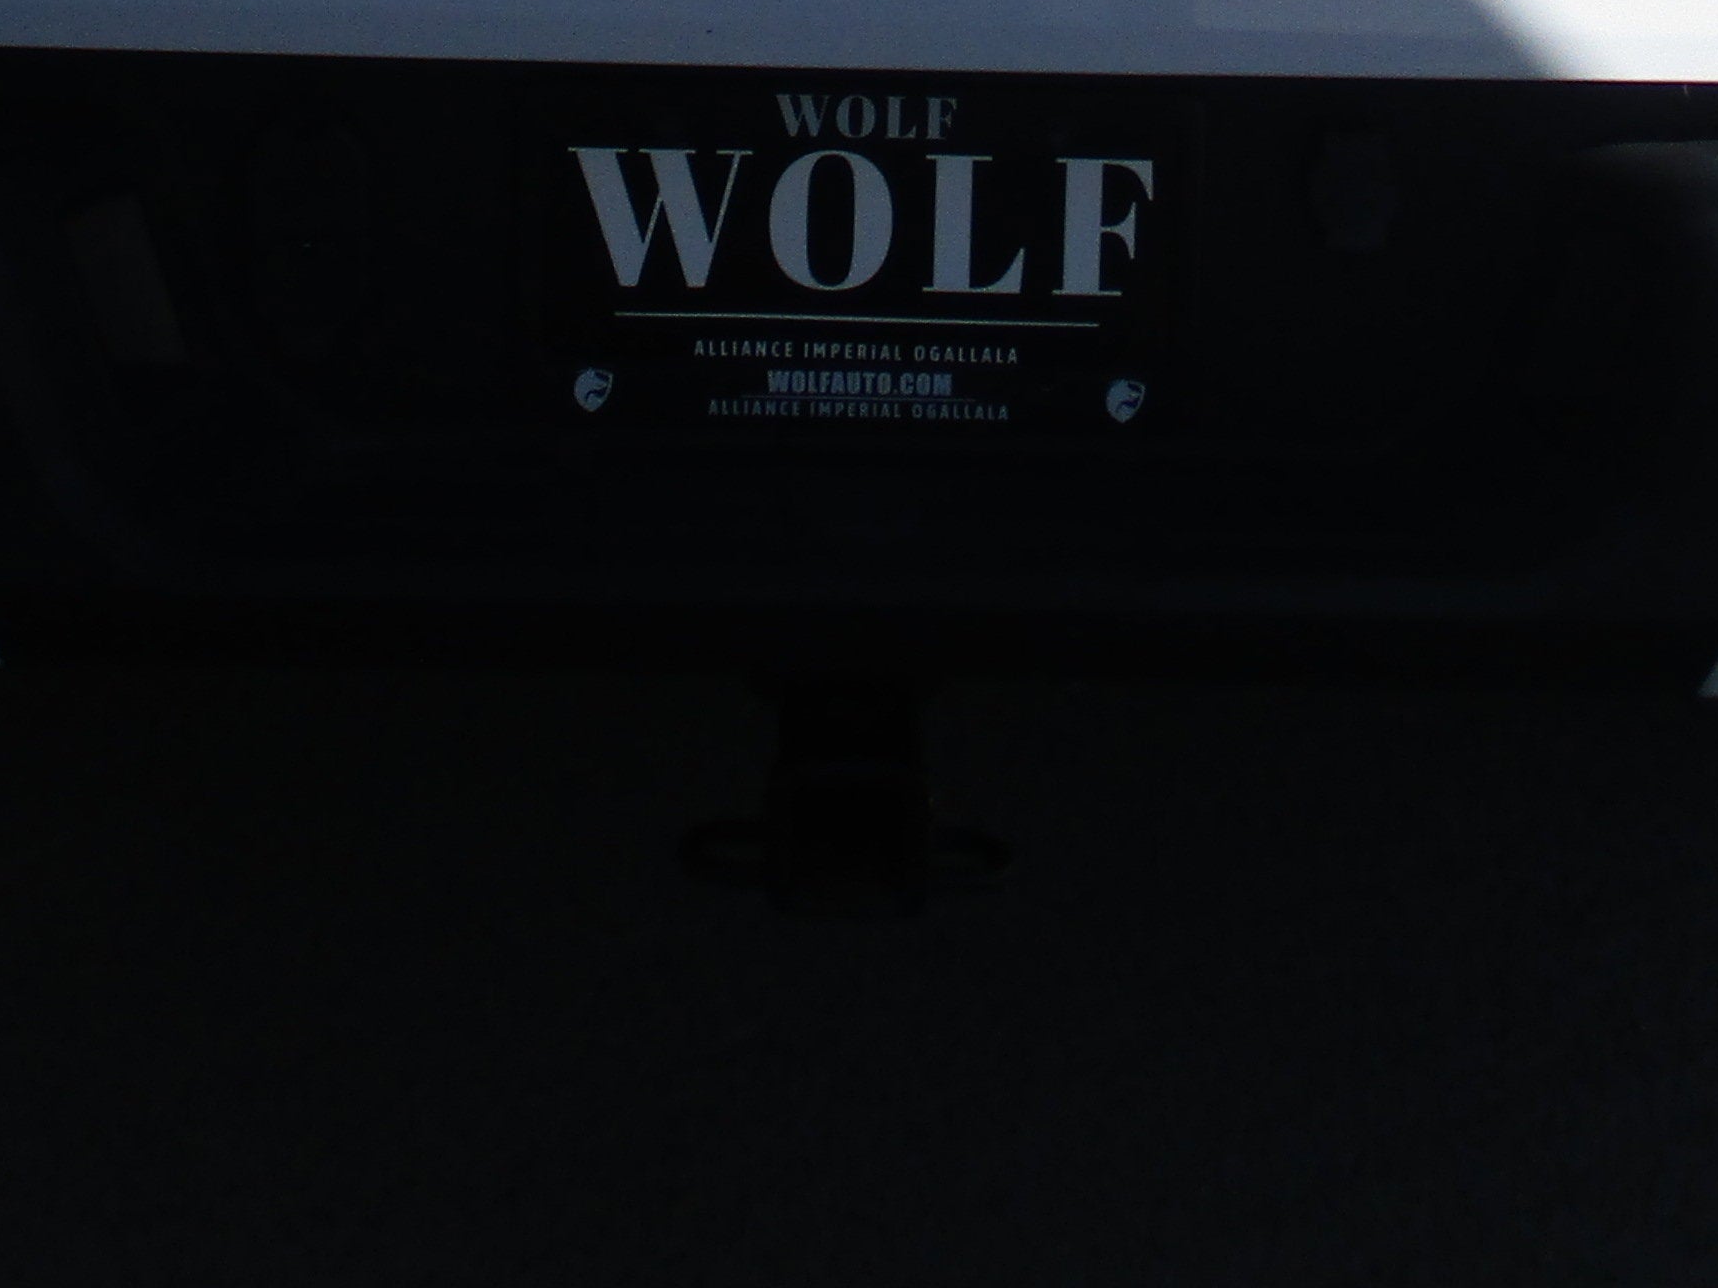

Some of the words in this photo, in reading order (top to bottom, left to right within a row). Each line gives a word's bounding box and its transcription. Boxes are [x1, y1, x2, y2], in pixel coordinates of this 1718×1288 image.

[777, 94, 958, 140] WOLF
[567, 146, 1155, 298] WOLF
[694, 339, 793, 359] ALLIANCE
[803, 342, 903, 362] IMPERIAL
[914, 344, 1019, 365] OGALLALA
[767, 370, 953, 397] WOLFAUTO.COM
[708, 398, 801, 417] ALLIANCE
[810, 400, 903, 419] IMPERIAL
[912, 402, 1010, 421] OGALLALA
